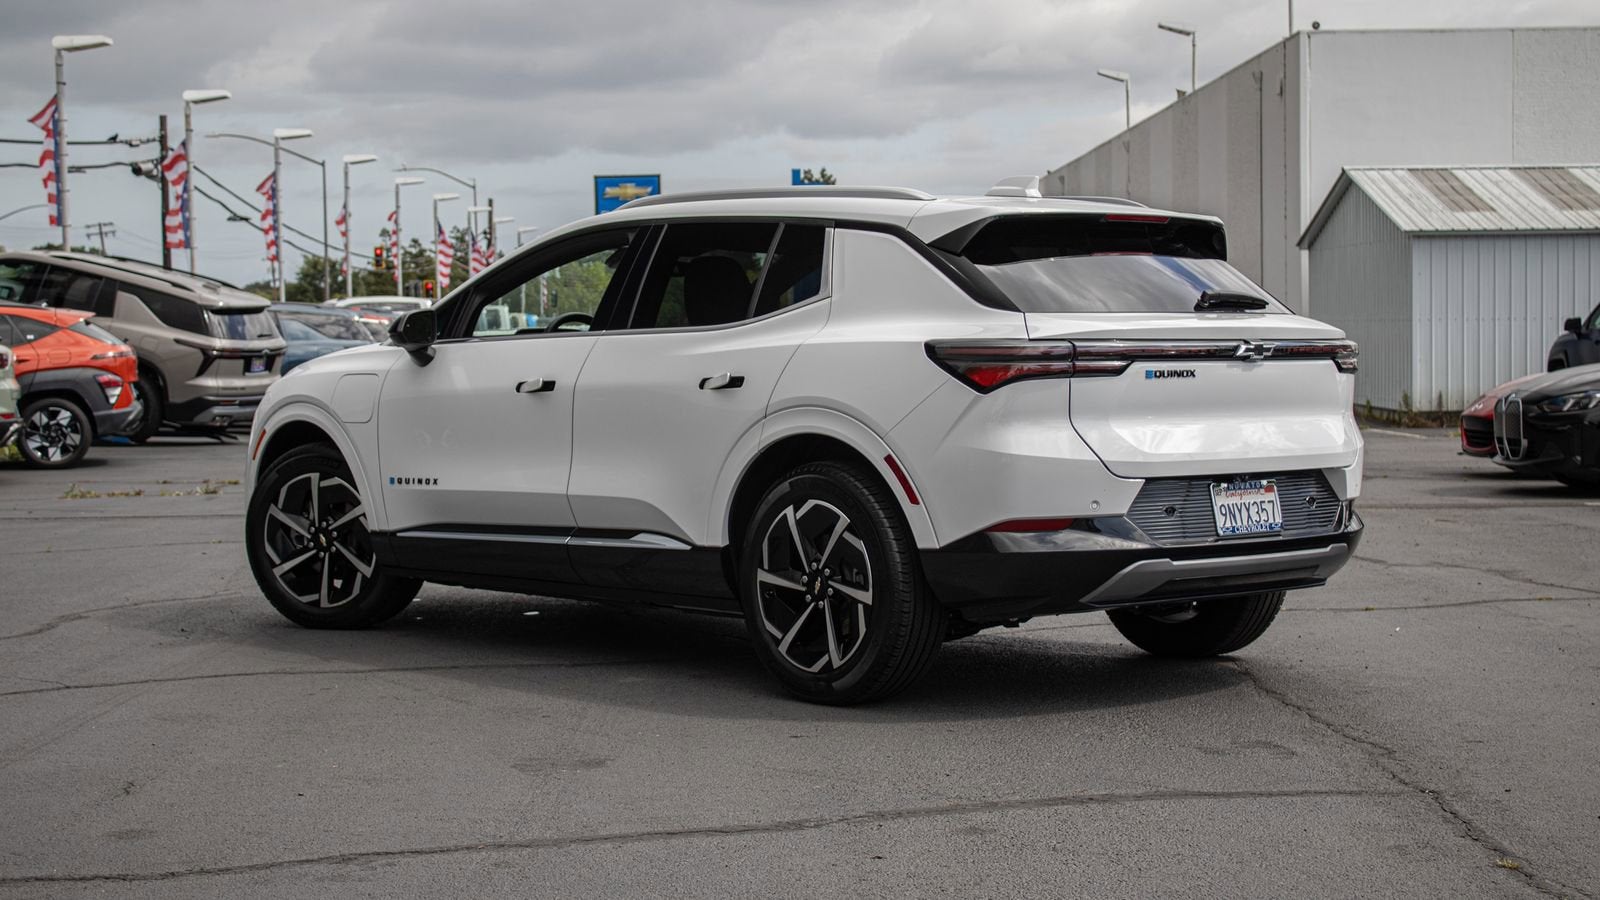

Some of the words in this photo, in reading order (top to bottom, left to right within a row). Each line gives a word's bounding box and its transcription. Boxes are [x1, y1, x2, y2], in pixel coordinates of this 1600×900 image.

[1145, 369, 1196, 379] EQUINOX
[1219, 501, 1275, 526] 9NYX357
[1235, 523, 1270, 533] CHEVROLET
